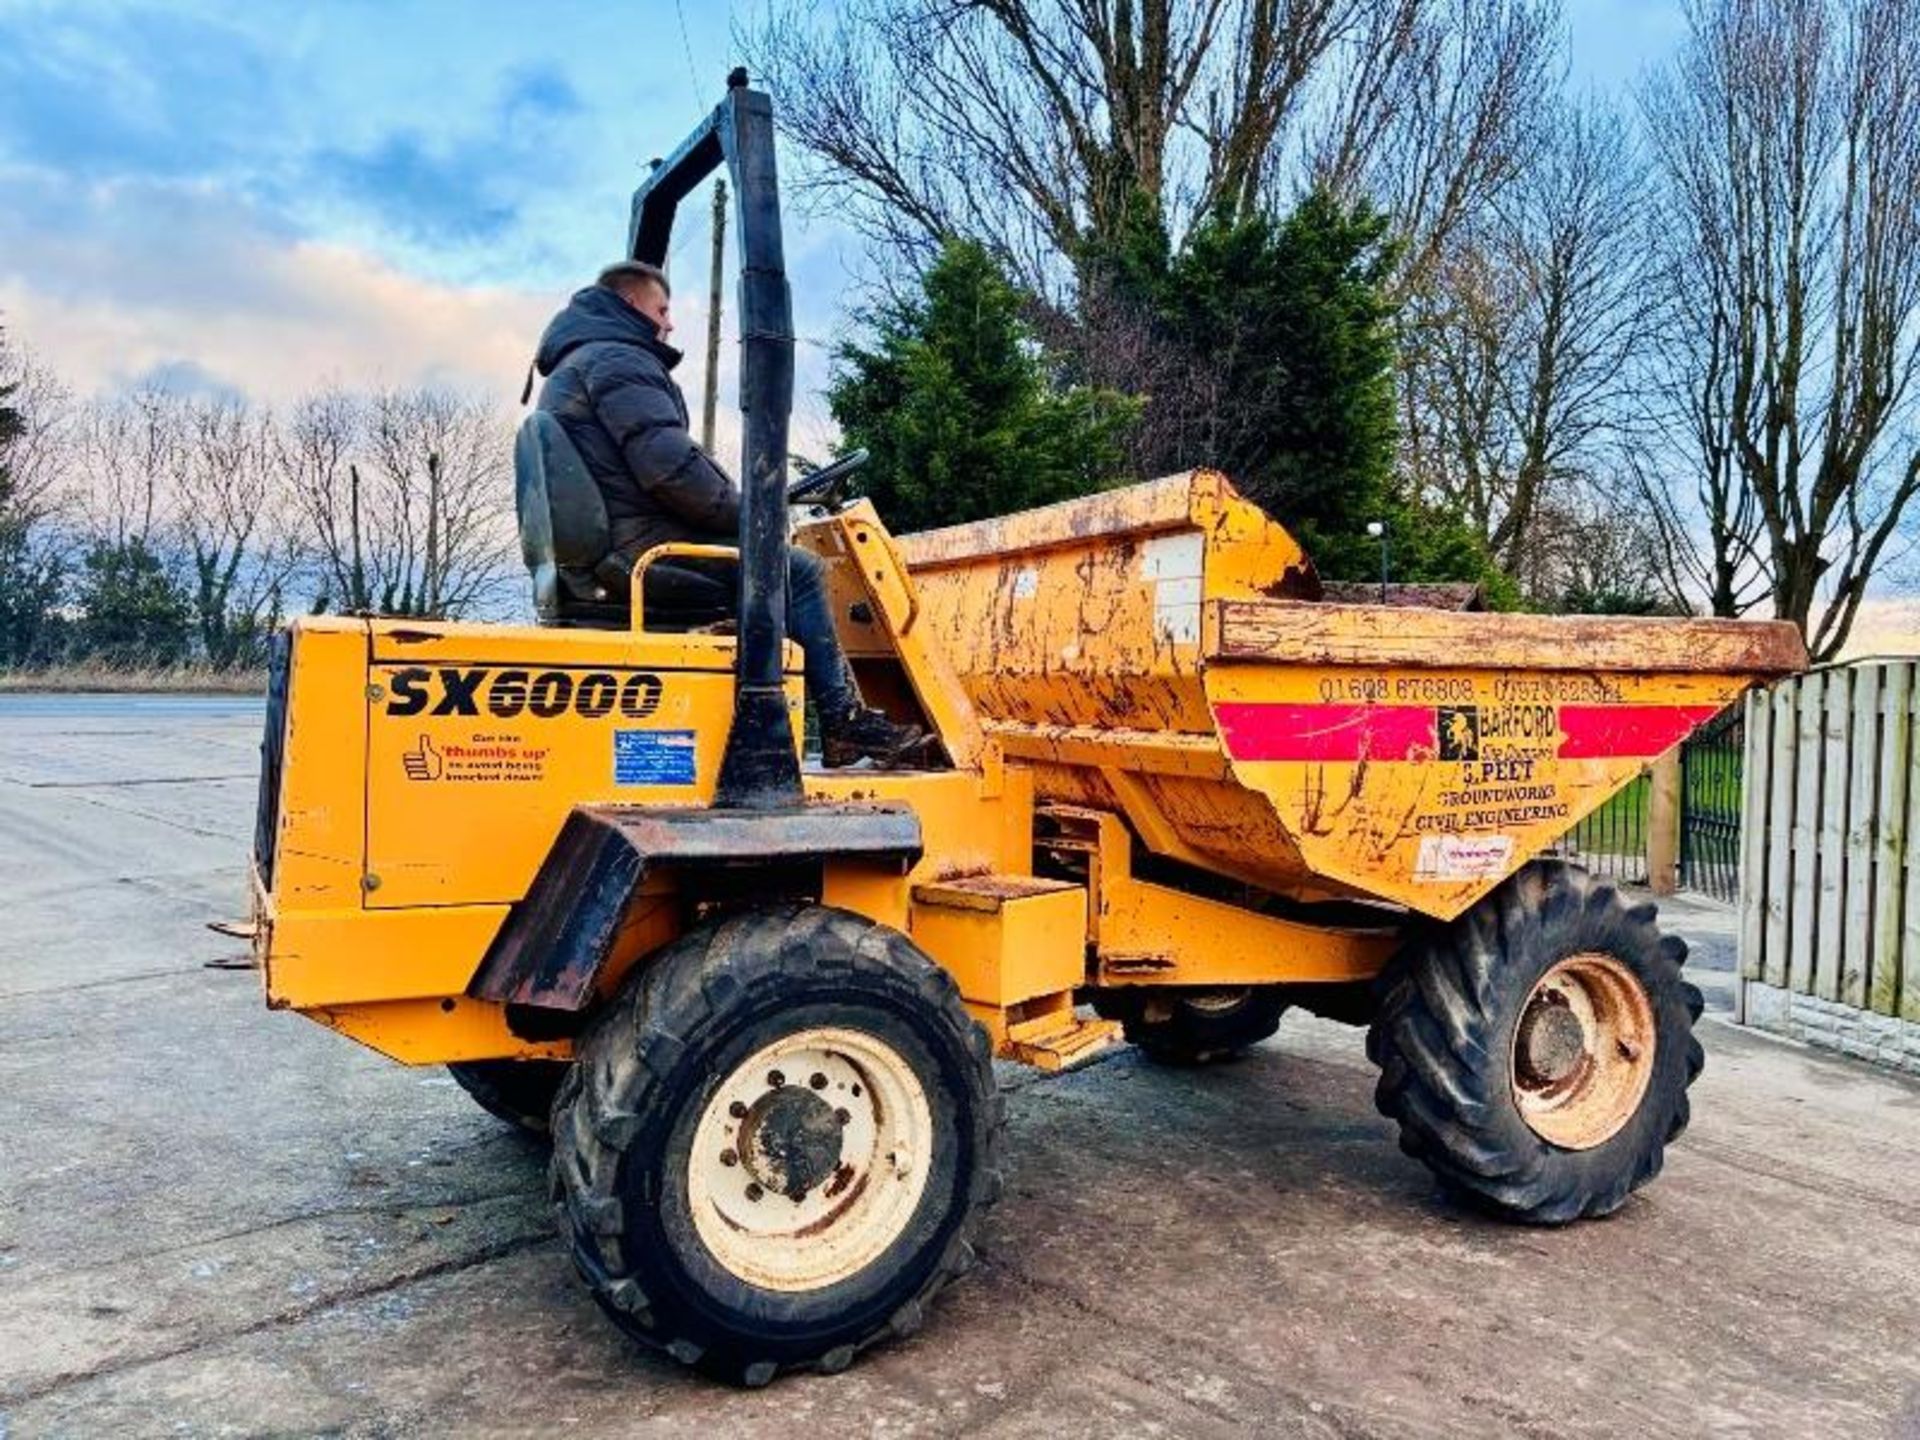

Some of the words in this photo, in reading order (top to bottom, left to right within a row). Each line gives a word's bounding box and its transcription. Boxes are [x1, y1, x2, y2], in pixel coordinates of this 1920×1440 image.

[386, 667, 663, 718] SX6000
[1480, 704, 1556, 738] BARFORD
[1415, 813, 1459, 830] CIVIL
